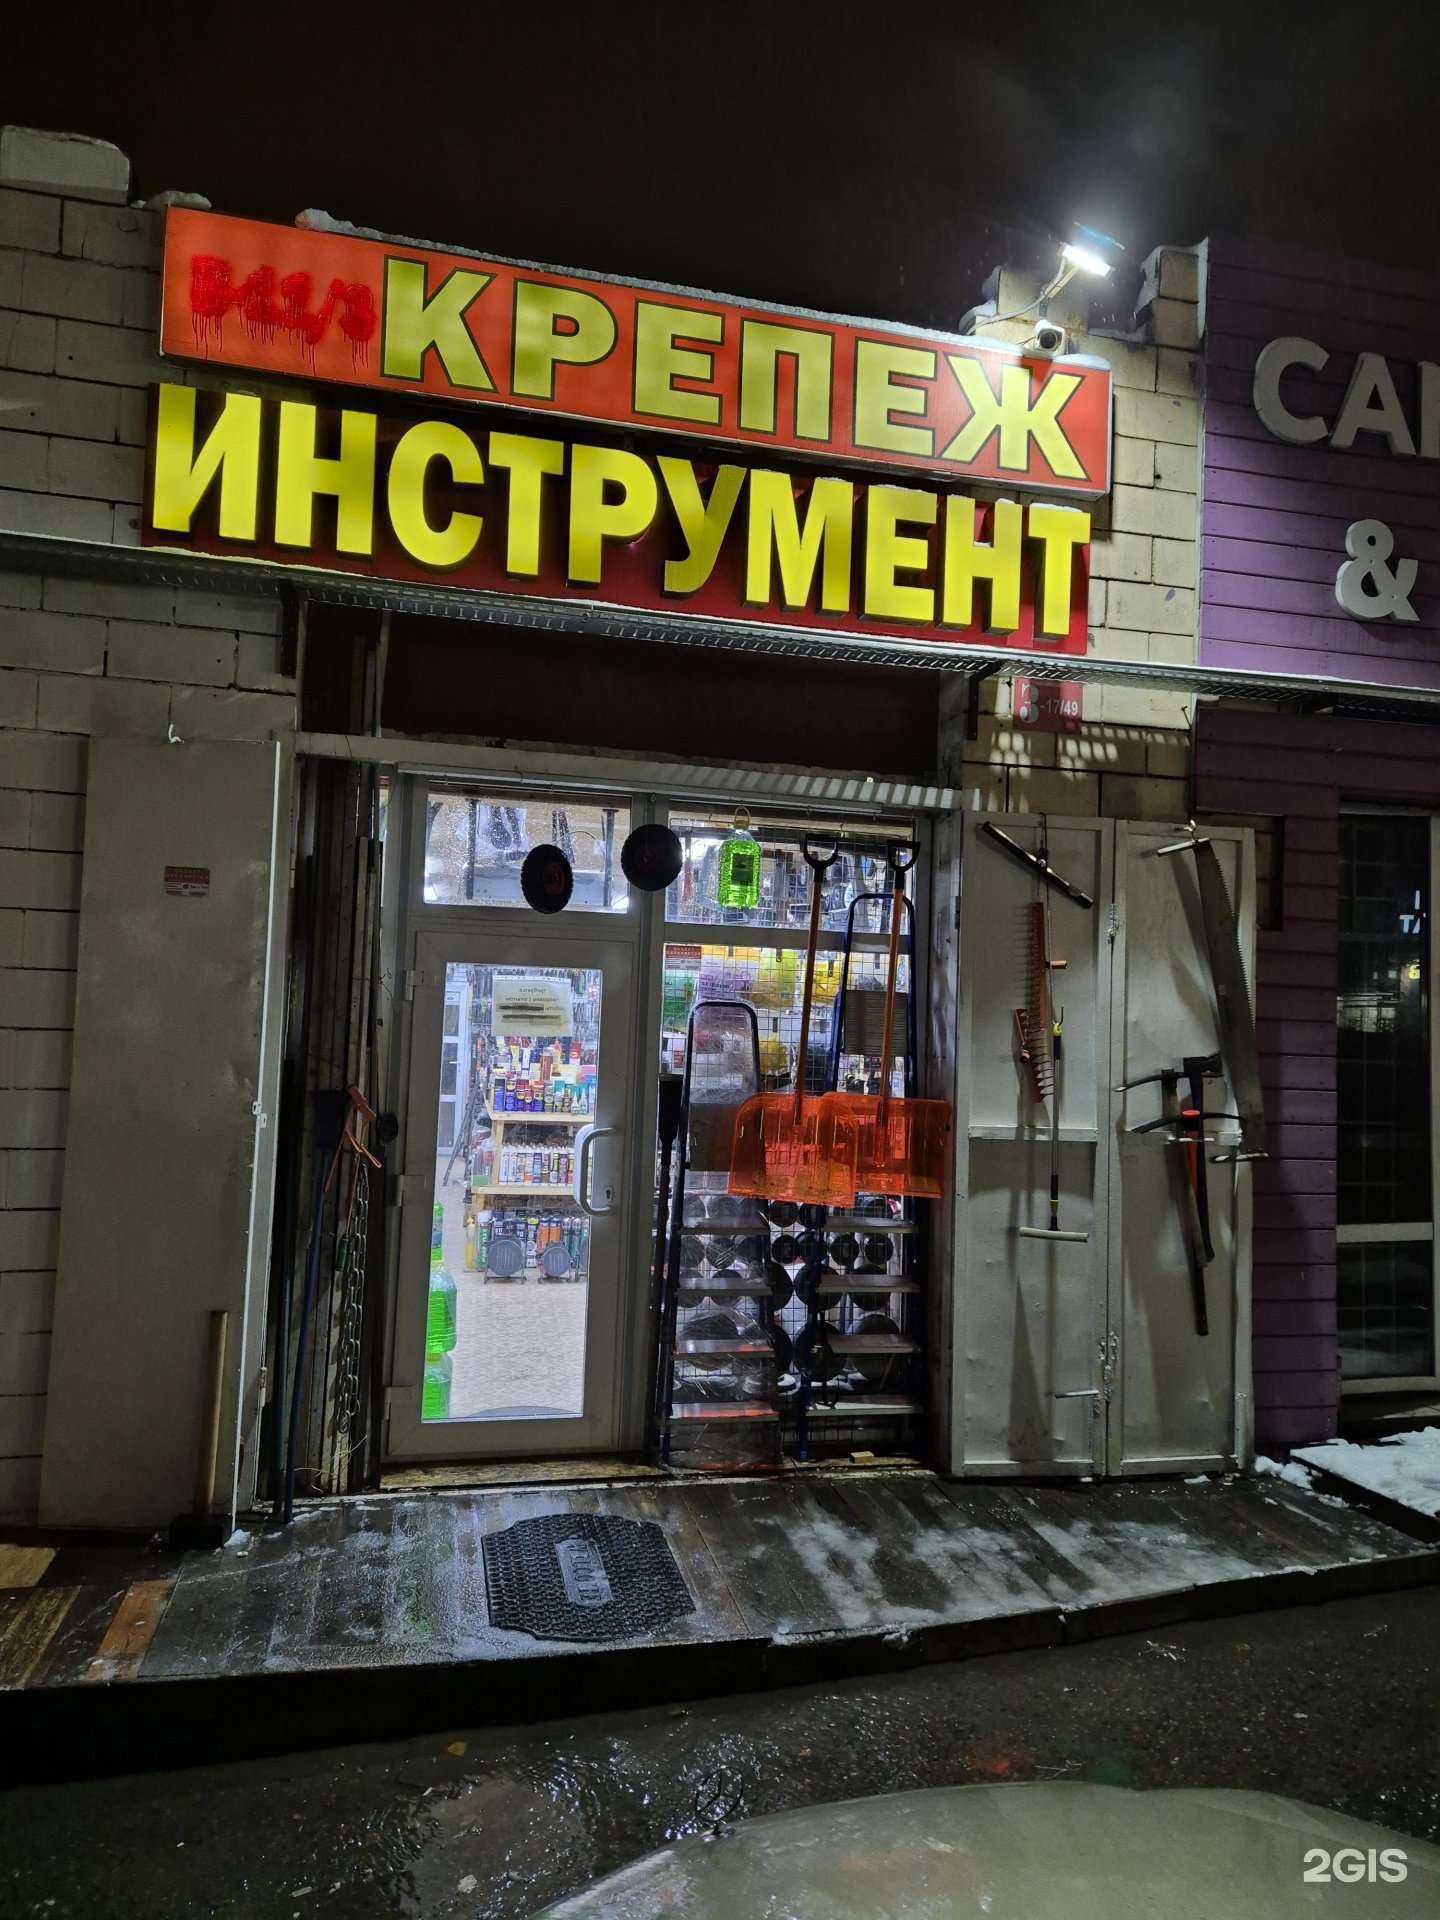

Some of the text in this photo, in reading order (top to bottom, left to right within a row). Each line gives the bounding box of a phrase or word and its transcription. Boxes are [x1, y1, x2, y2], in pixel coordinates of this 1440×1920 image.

[381, 254, 1091, 482] КРЕПЕЖ
[152, 382, 1092, 637] ИНСТРУМЕНТ
[1335, 518, 1420, 622] &
